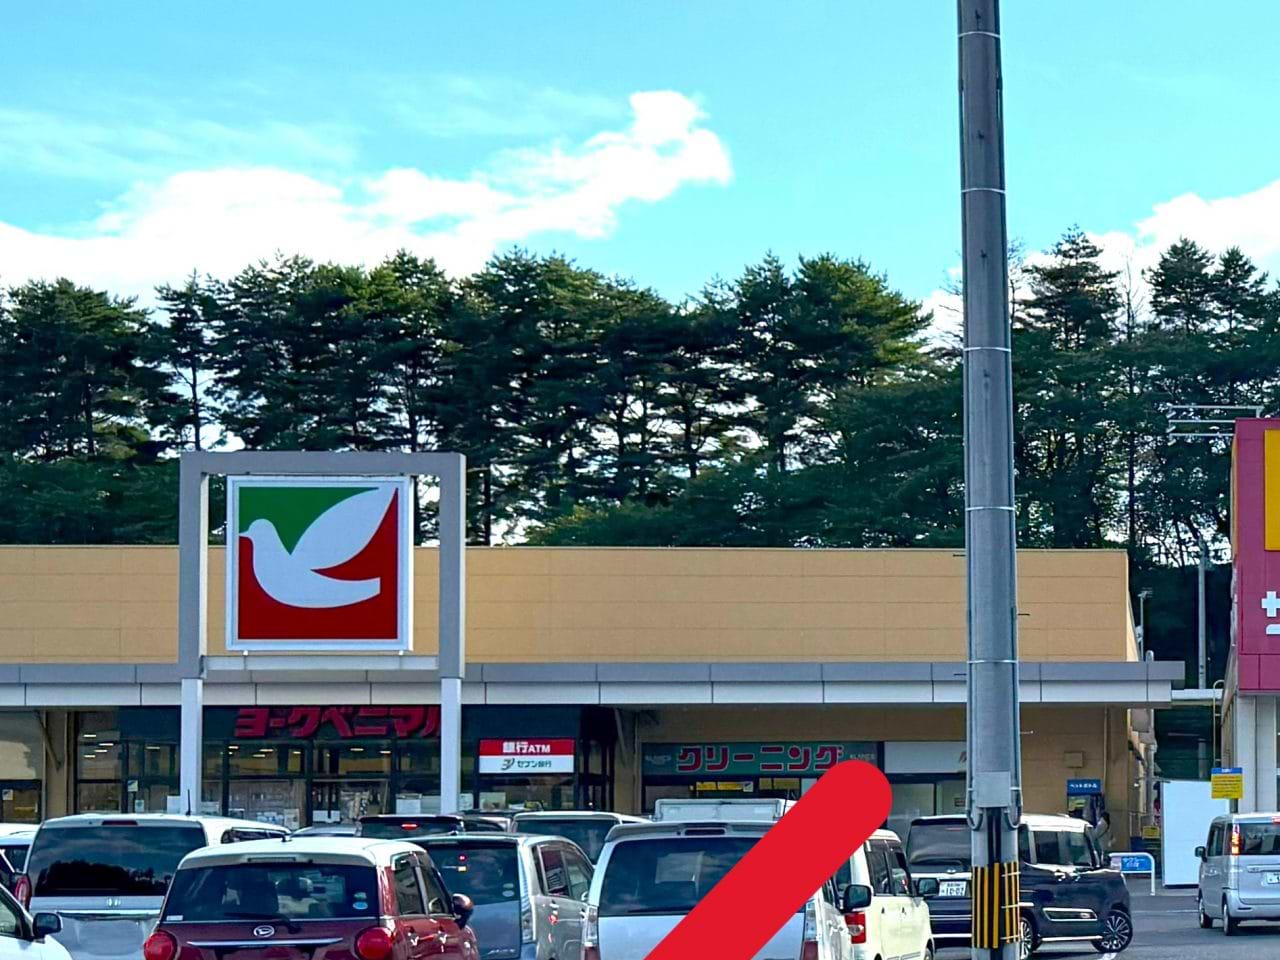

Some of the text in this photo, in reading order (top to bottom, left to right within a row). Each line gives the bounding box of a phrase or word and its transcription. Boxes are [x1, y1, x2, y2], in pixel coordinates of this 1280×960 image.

[502, 740, 551, 754] 銀行ATM
[676, 745, 844, 772] クリーニング
